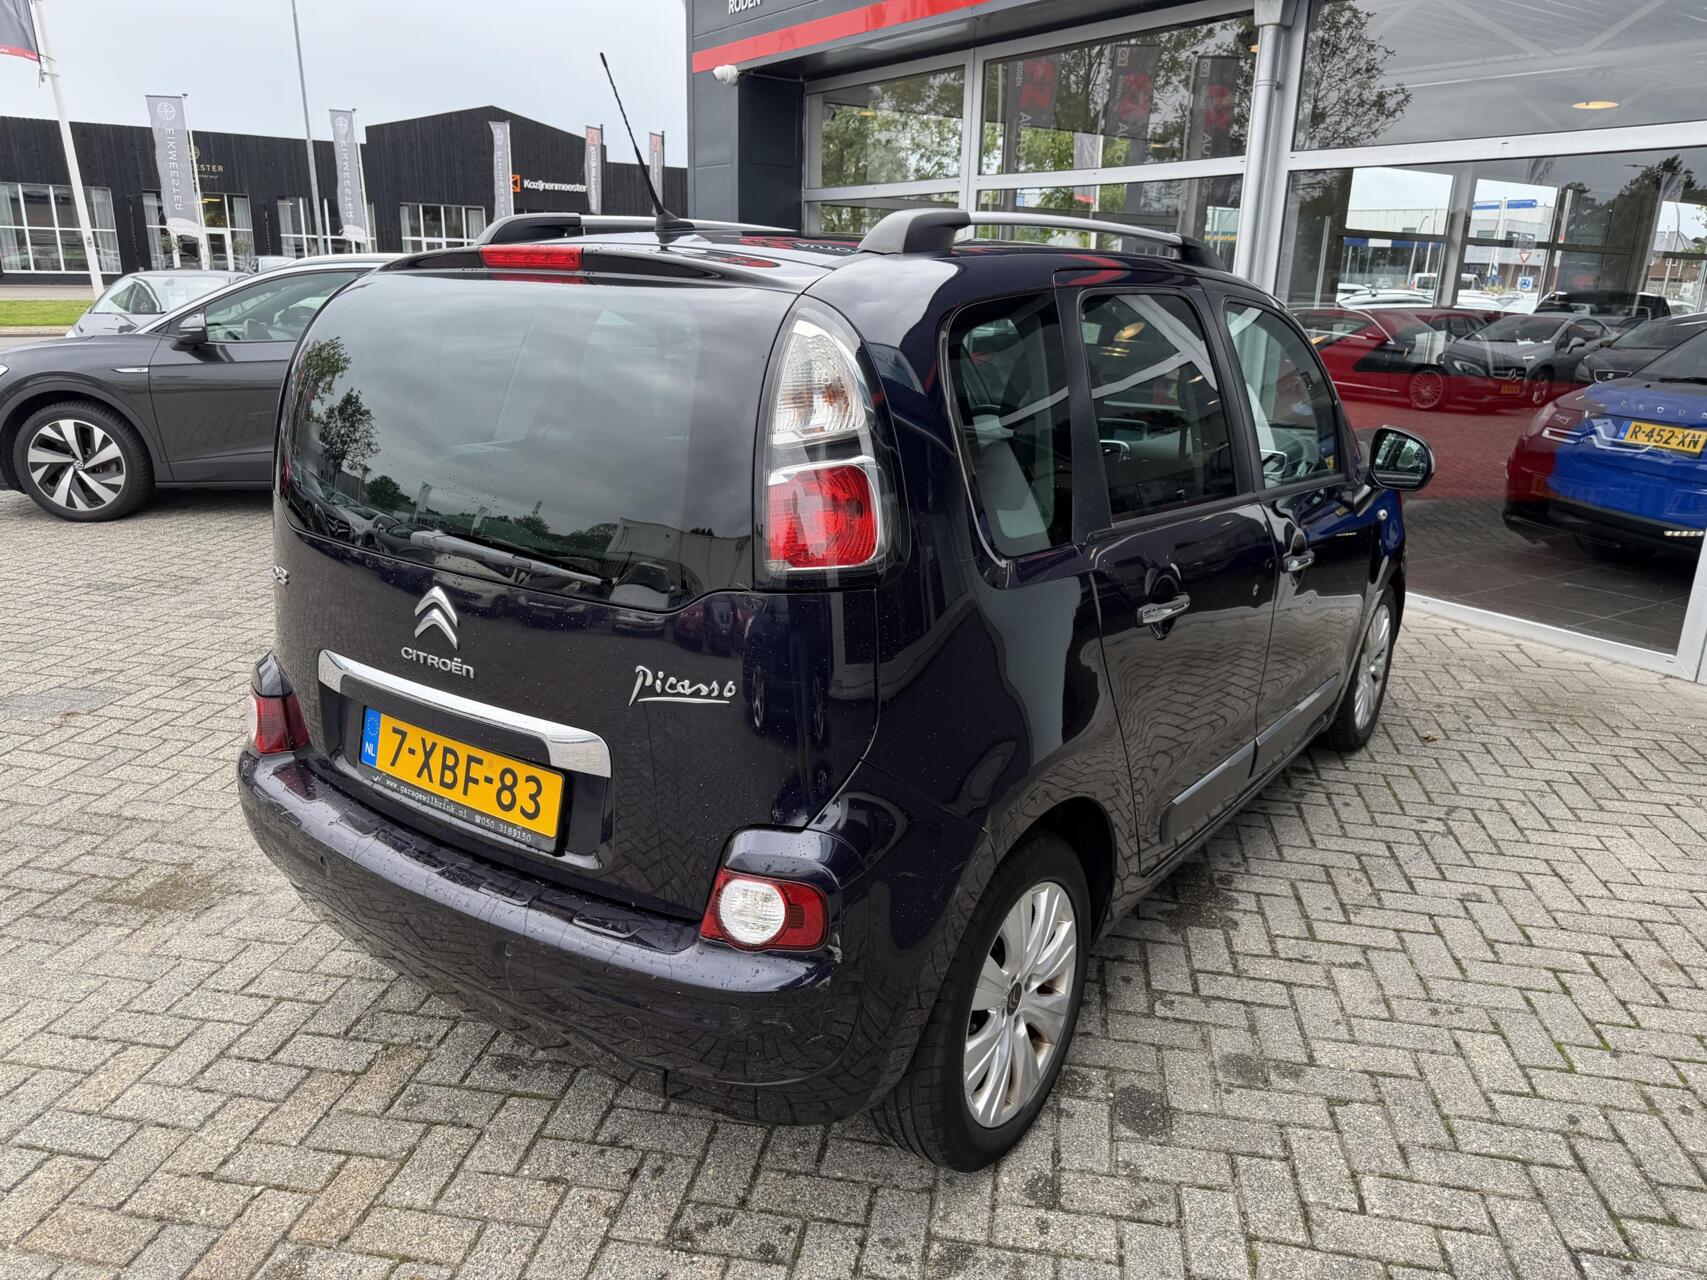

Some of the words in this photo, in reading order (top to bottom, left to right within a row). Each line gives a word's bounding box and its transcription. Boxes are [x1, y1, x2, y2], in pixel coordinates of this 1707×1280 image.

[1630, 424, 1701, 449] R-452-XN
[629, 665, 736, 706] Picasso
[364, 741, 376, 758] NL
[390, 726, 543, 820] 7-XBF-83
[385, 778, 468, 819] www.garagewilbrink.nl
[480, 817, 495, 830] 050
[499, 824, 532, 843] 3189150
